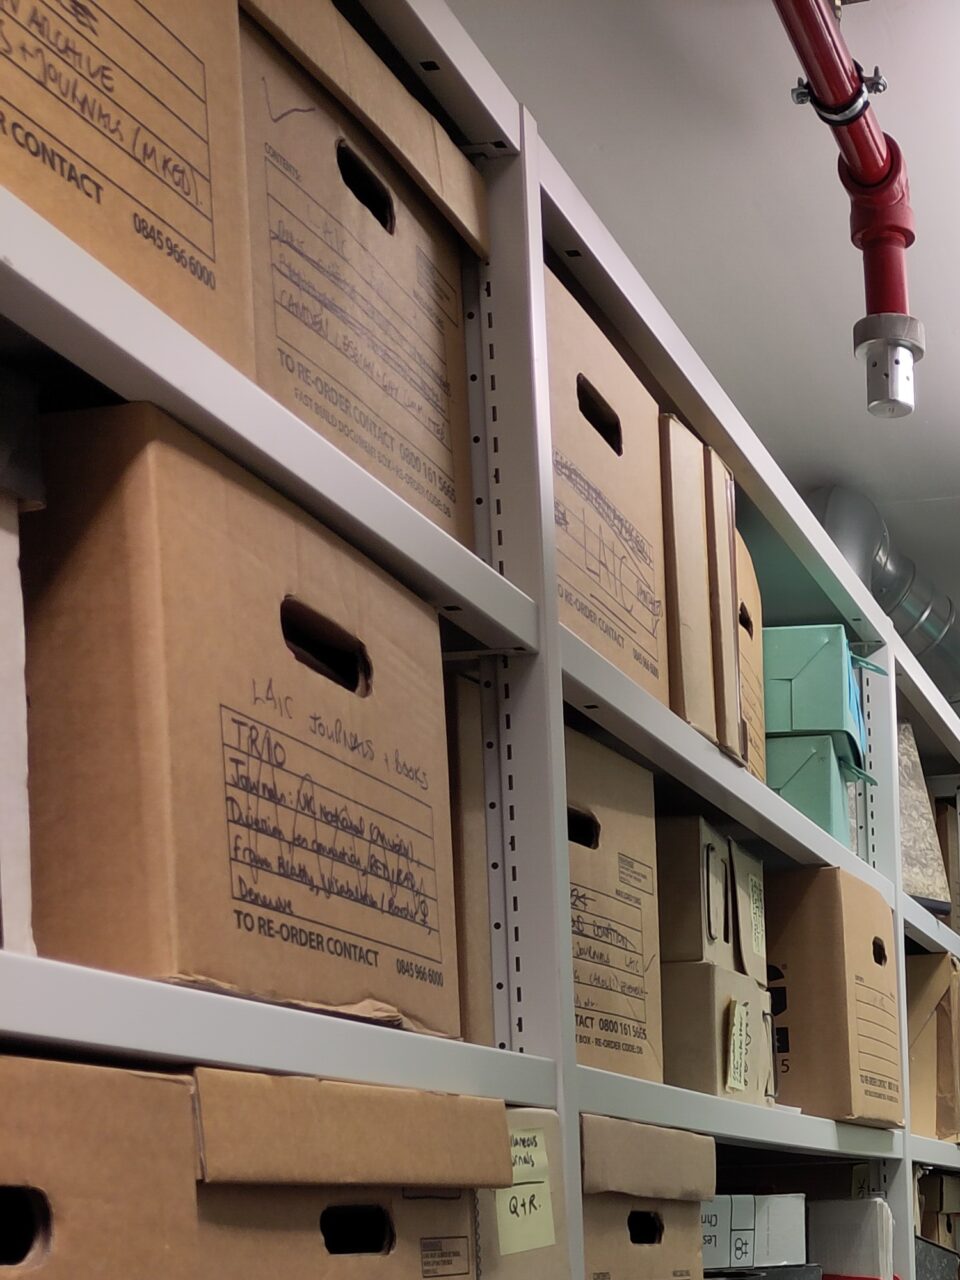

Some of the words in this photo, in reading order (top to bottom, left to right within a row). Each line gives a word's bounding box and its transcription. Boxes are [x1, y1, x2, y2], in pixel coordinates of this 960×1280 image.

[11, 121, 104, 205] CONTACT
[132, 211, 164, 252] 0845
[166, 241, 189, 270] 966
[188, 257, 217, 291] 6000
[277, 346, 297, 374] TO
[297, 360, 352, 415] RE-ORDER
[351, 405, 397, 452] CONTACT
[598, 614, 626, 651] CONTACT
[308, 712, 376, 762] JOURNALS
[233, 909, 255, 932] TO
[257, 915, 325, 952] RE-ORDER
[326, 936, 380, 968] CONTACT
[395, 957, 415, 979] 0845
[414, 962, 428, 983] 966
[427, 967, 444, 988] 6000
[578, 1035, 592, 1046] BOX
[598, 1017, 619, 1034] 0800
[619, 1023, 632, 1037] 161
